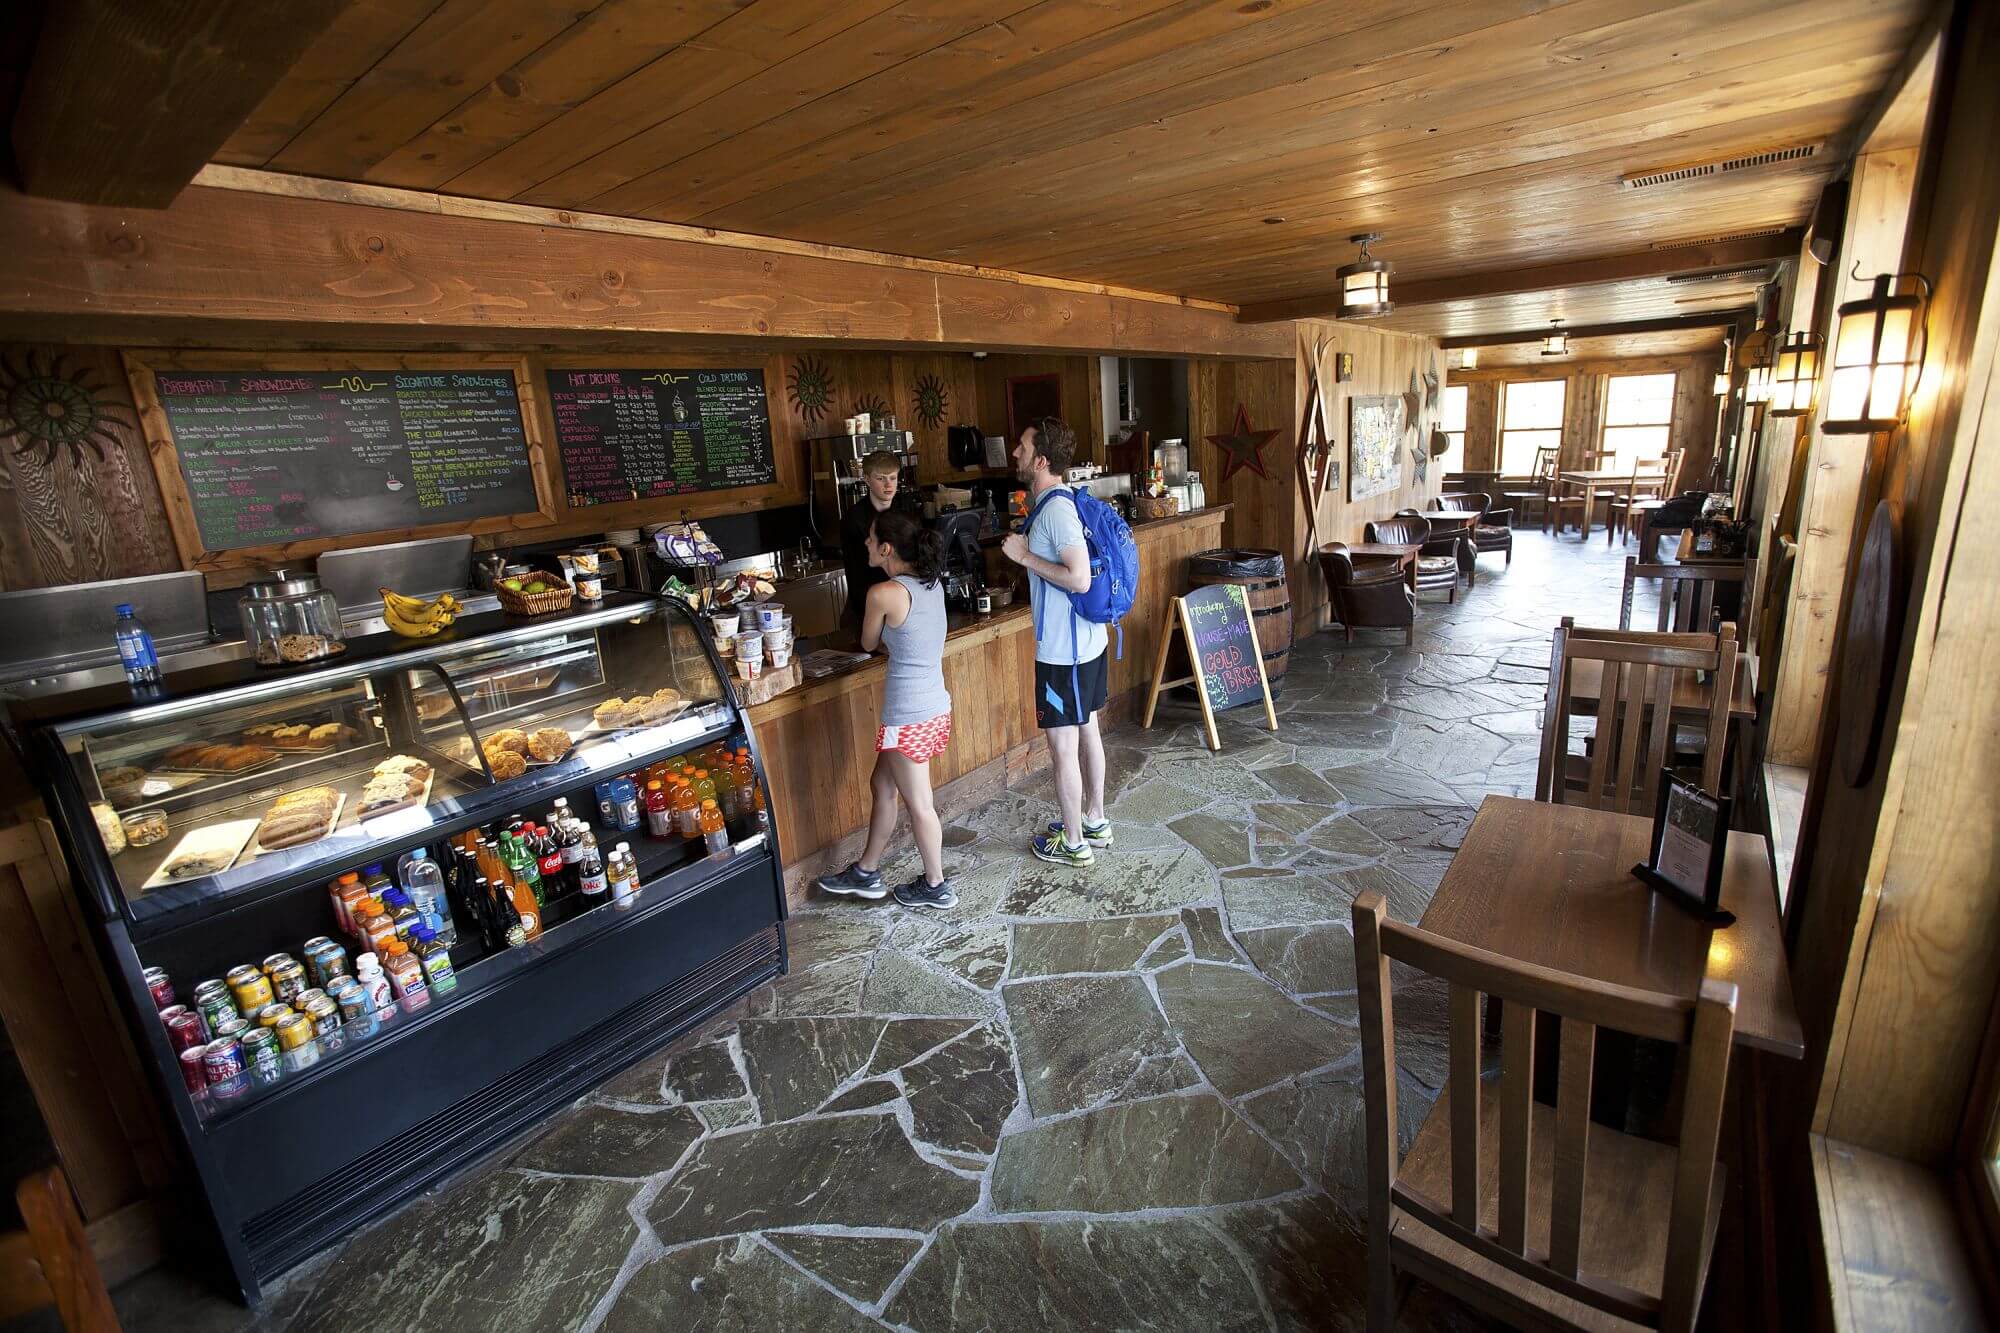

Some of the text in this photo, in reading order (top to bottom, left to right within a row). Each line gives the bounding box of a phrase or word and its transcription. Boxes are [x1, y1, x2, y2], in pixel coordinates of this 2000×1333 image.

[394, 375, 508, 389] SIGNATURE SANDWICHES
[568, 372, 621, 387] HOT DRINKS
[698, 372, 749, 384] COLD DRINKS
[240, 379, 313, 393] SANDWICHES
[404, 431, 422, 440] THE
[425, 430, 443, 438] CLUB
[561, 433, 598, 442] ESPRESSO
[409, 450, 432, 459] TUNA
[435, 448, 457, 457] SALAD
[1196, 619, 1250, 648] HOUSE-MADE
[1204, 645, 1243, 675] COLD
[1222, 661, 1261, 695] BREW
[208, 1062, 237, 1074] ALE'S
